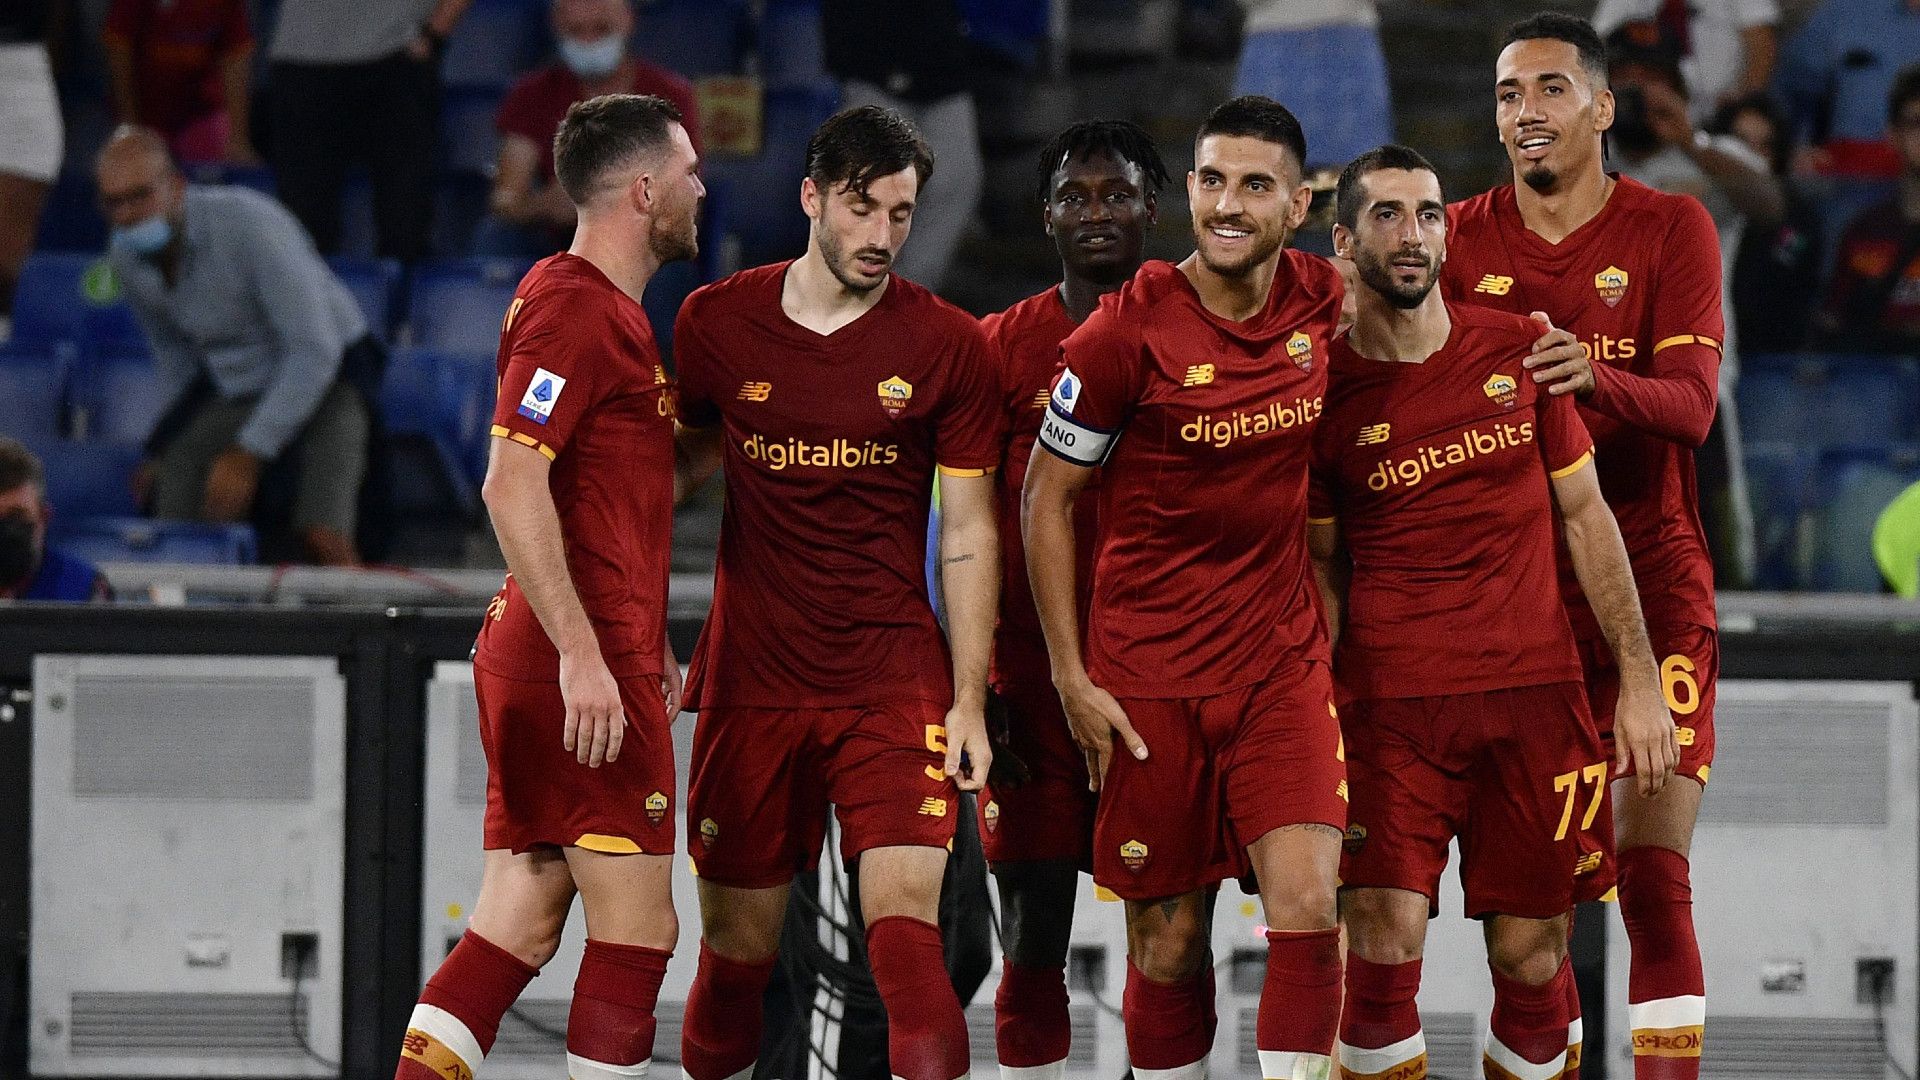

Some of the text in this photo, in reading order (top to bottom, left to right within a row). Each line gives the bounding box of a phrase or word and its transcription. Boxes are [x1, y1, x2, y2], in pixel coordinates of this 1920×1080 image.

[882, 399, 906, 408] ROMA
[1180, 396, 1323, 448] digitalbits
[743, 433, 899, 470] digitalbits
[1368, 422, 1533, 491] digitalbits
[1554, 761, 1608, 842] 77
